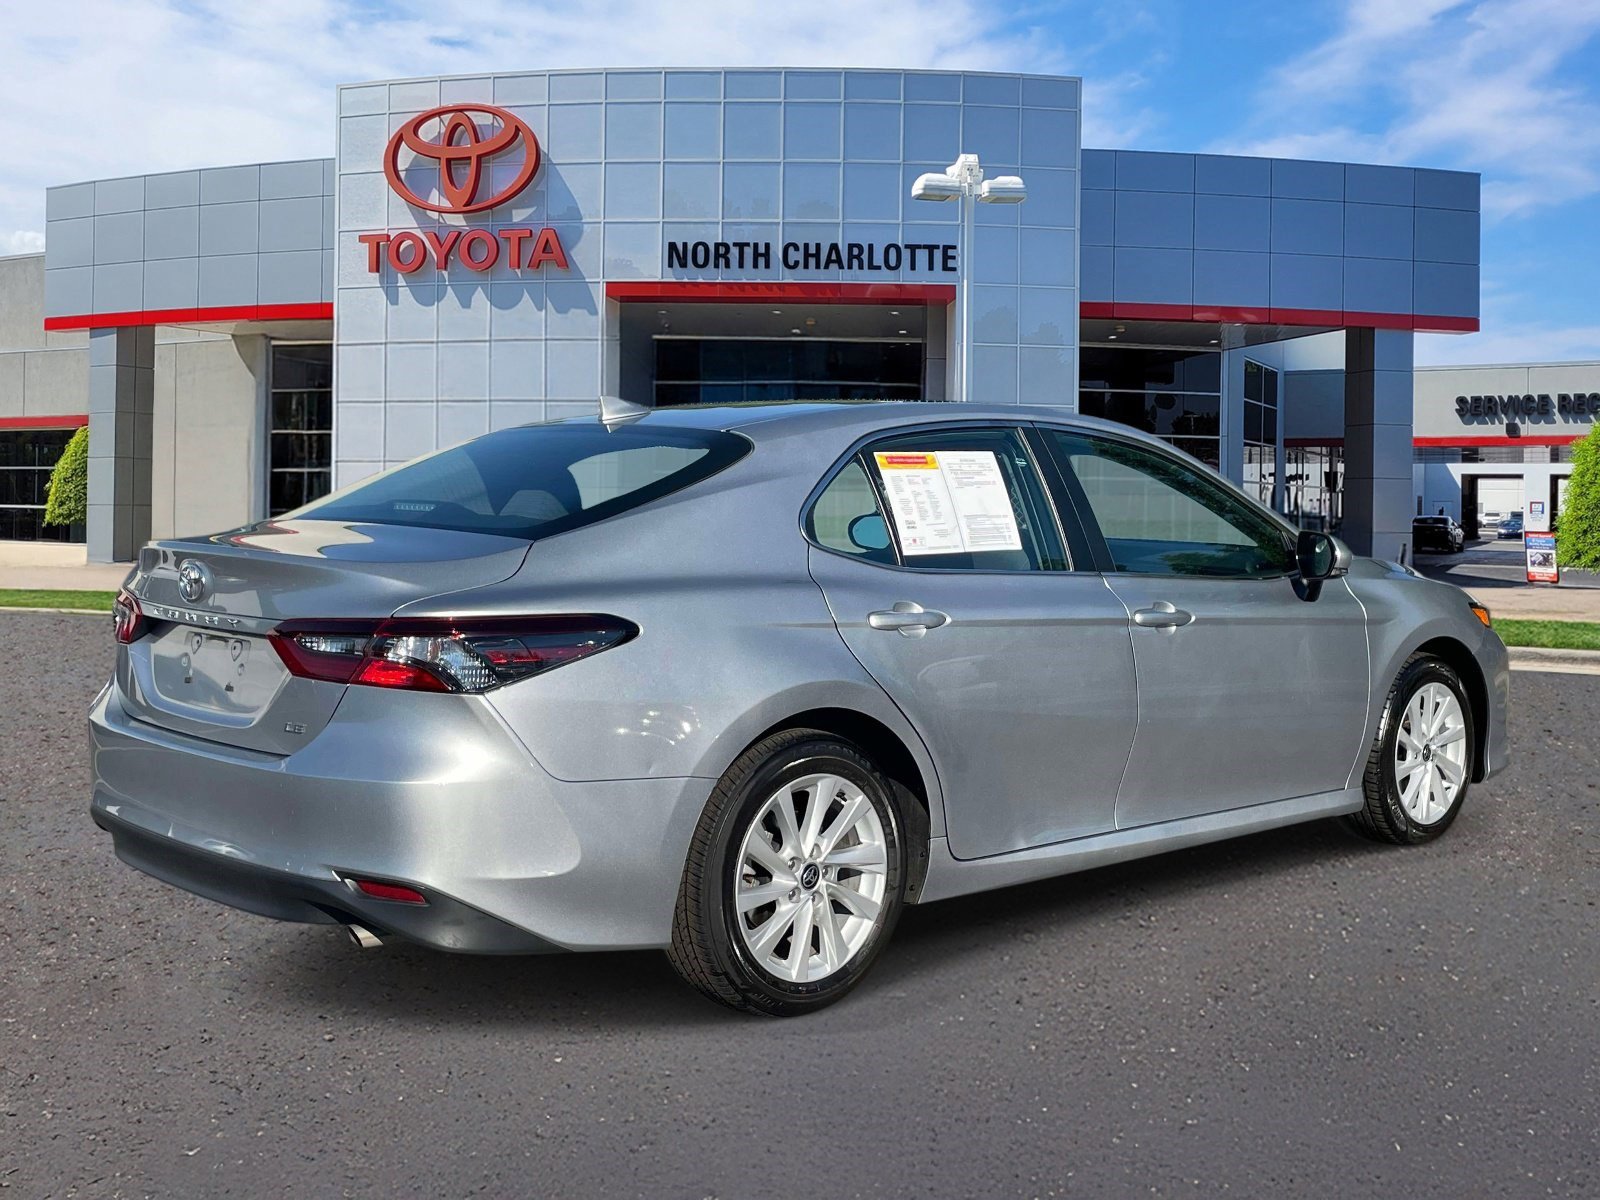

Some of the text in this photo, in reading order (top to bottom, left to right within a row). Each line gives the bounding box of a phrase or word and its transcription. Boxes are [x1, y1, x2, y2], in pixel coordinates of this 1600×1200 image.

[358, 228, 569, 274] TOYOTA
[667, 240, 957, 272] NORTH CHARLOTTE
[1455, 394, 1550, 417] SERVICE
[152, 606, 241, 628] CAMRY
